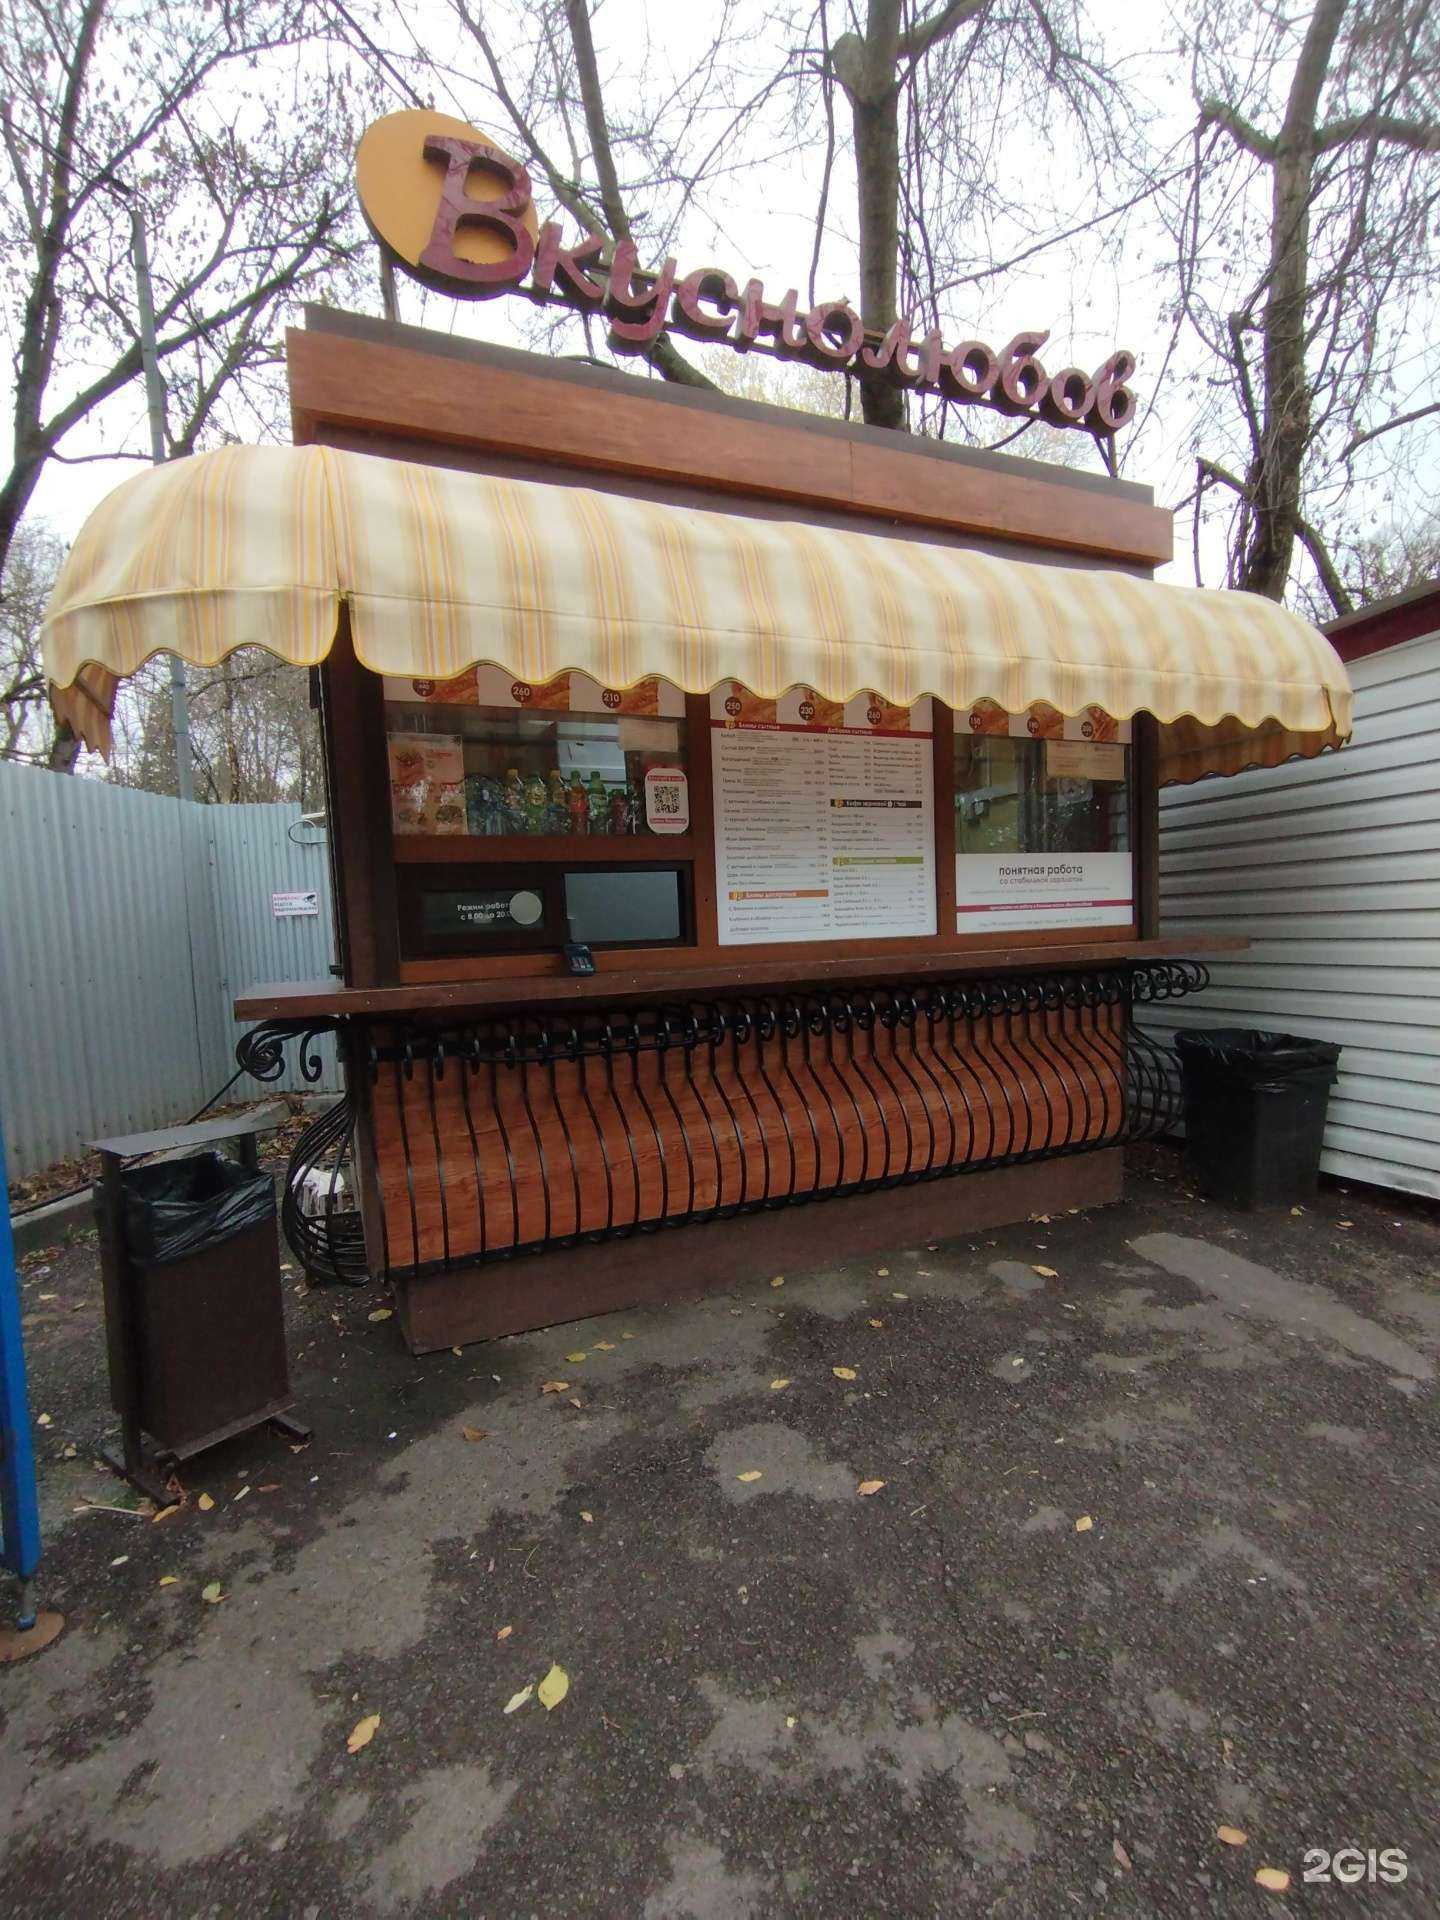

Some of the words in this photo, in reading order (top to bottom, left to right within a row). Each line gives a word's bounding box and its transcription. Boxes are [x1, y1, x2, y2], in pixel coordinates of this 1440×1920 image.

[422, 134, 1138, 431] Вкуснолюбов
[513, 687, 530, 696] 260
[603, 693, 619, 702] 210
[999, 866, 1045, 876] понятная
[1047, 864, 1083, 877] работа
[485, 902, 510, 911] работ
